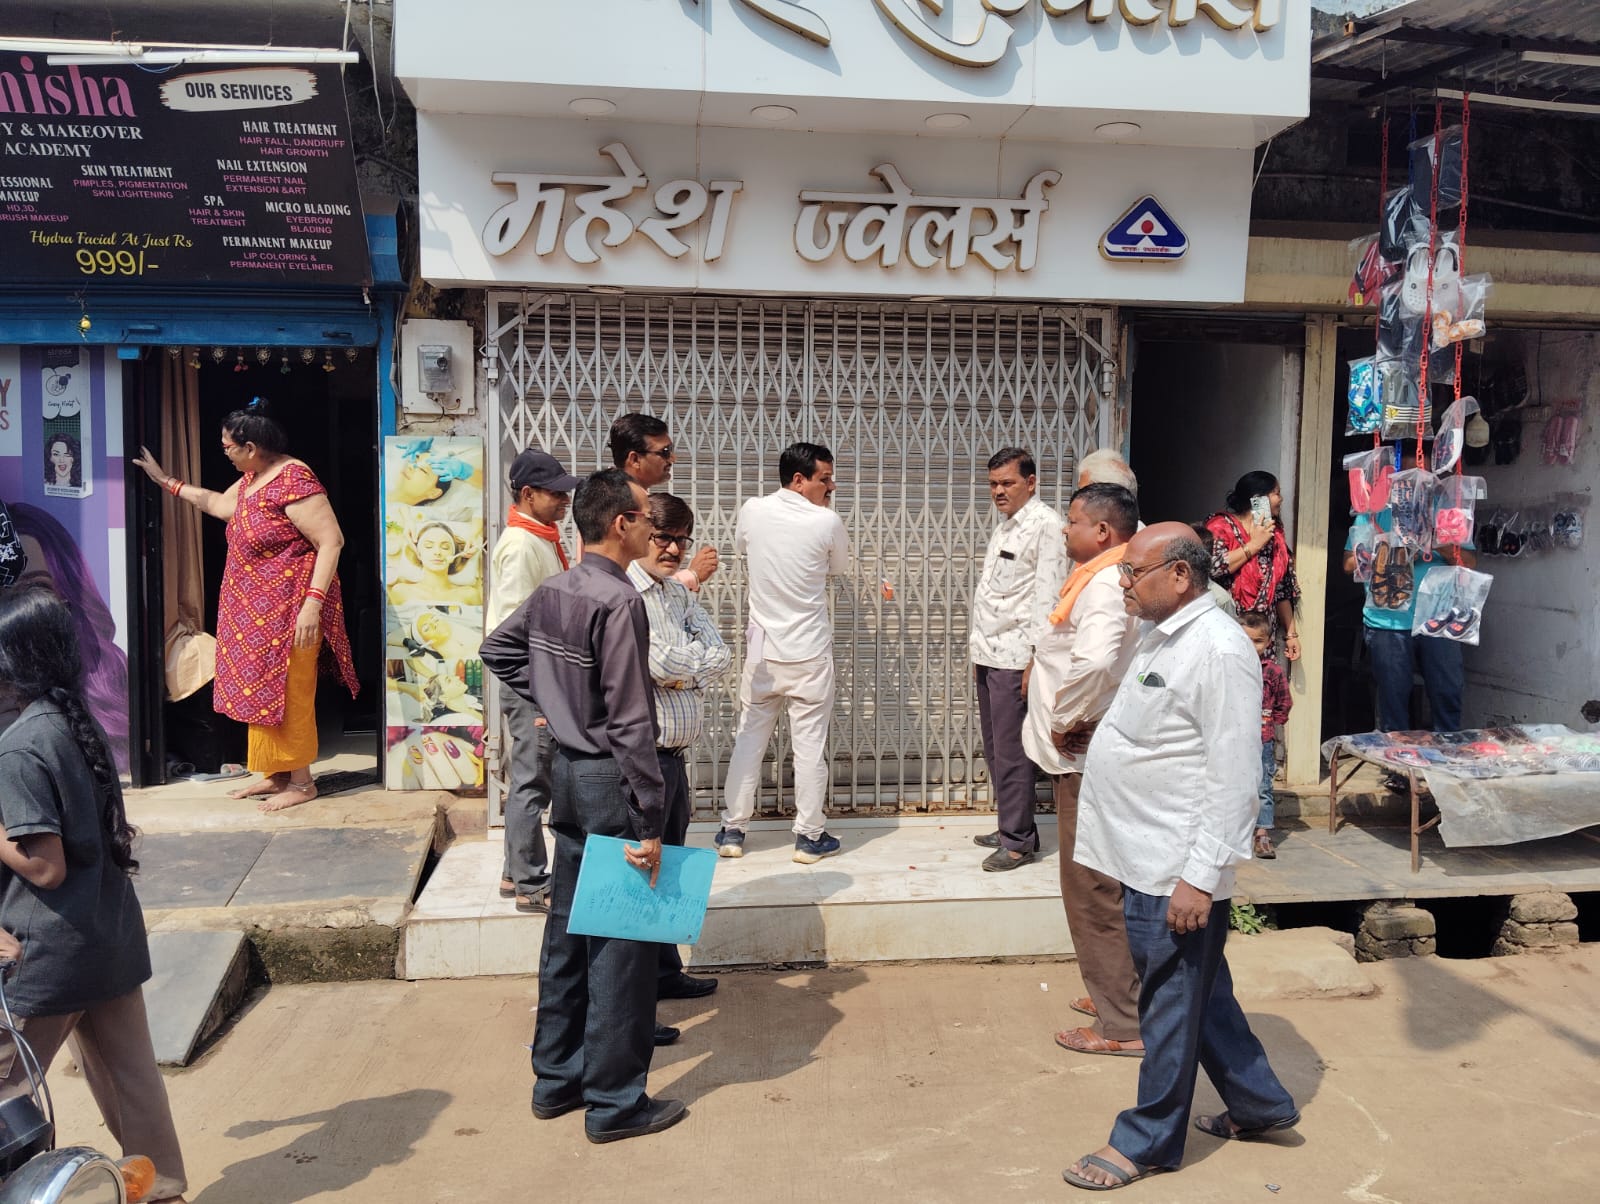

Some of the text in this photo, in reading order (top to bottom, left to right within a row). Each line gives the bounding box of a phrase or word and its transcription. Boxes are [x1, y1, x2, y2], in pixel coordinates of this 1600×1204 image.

[185, 82, 293, 101] OUR SERVICES
[20, 122, 34, 136] &
[37, 123, 144, 140] MAKEOVER
[242, 121, 337, 136] HAIR TREATMENT
[239, 136, 345, 148] HAIR FALL, DANDRUFF
[4, 141, 92, 157] ACADEMY
[260, 147, 329, 157] HAIR GROWTH
[80, 165, 173, 178] SKIN TREATMENT
[216, 159, 308, 173] NAIL EXTENSION
[0, 176, 54, 189] ESSIONAL
[73, 179, 188, 190] PIMPLES, PIGMENTATION
[223, 175, 306, 185] PERMANENT NAIL
[92, 189, 174, 199] SKIN LIGHTENING
[225, 185, 279, 194] EXTENSION
[204, 195, 225, 207] SPA
[482, 142, 1063, 272] महेश ज्वेलर्स
[189, 208, 245, 217] HAIR & SKIN
[265, 201, 351, 216] MICRO BLADING
[30, 214, 69, 222] MAKEUP
[191, 218, 246, 227] TREATMENT
[286, 216, 333, 225] EYEBROW
[290, 225, 332, 234] BLADING
[30, 230, 193, 249] Hydra Facial At Just Rs
[222, 236, 333, 250] PERMANENT MAKEUP
[75, 248, 159, 276] 999/-
[243, 252, 317, 261] LIP COLORING &
[230, 260, 334, 271] PERMANENT EYELINER
